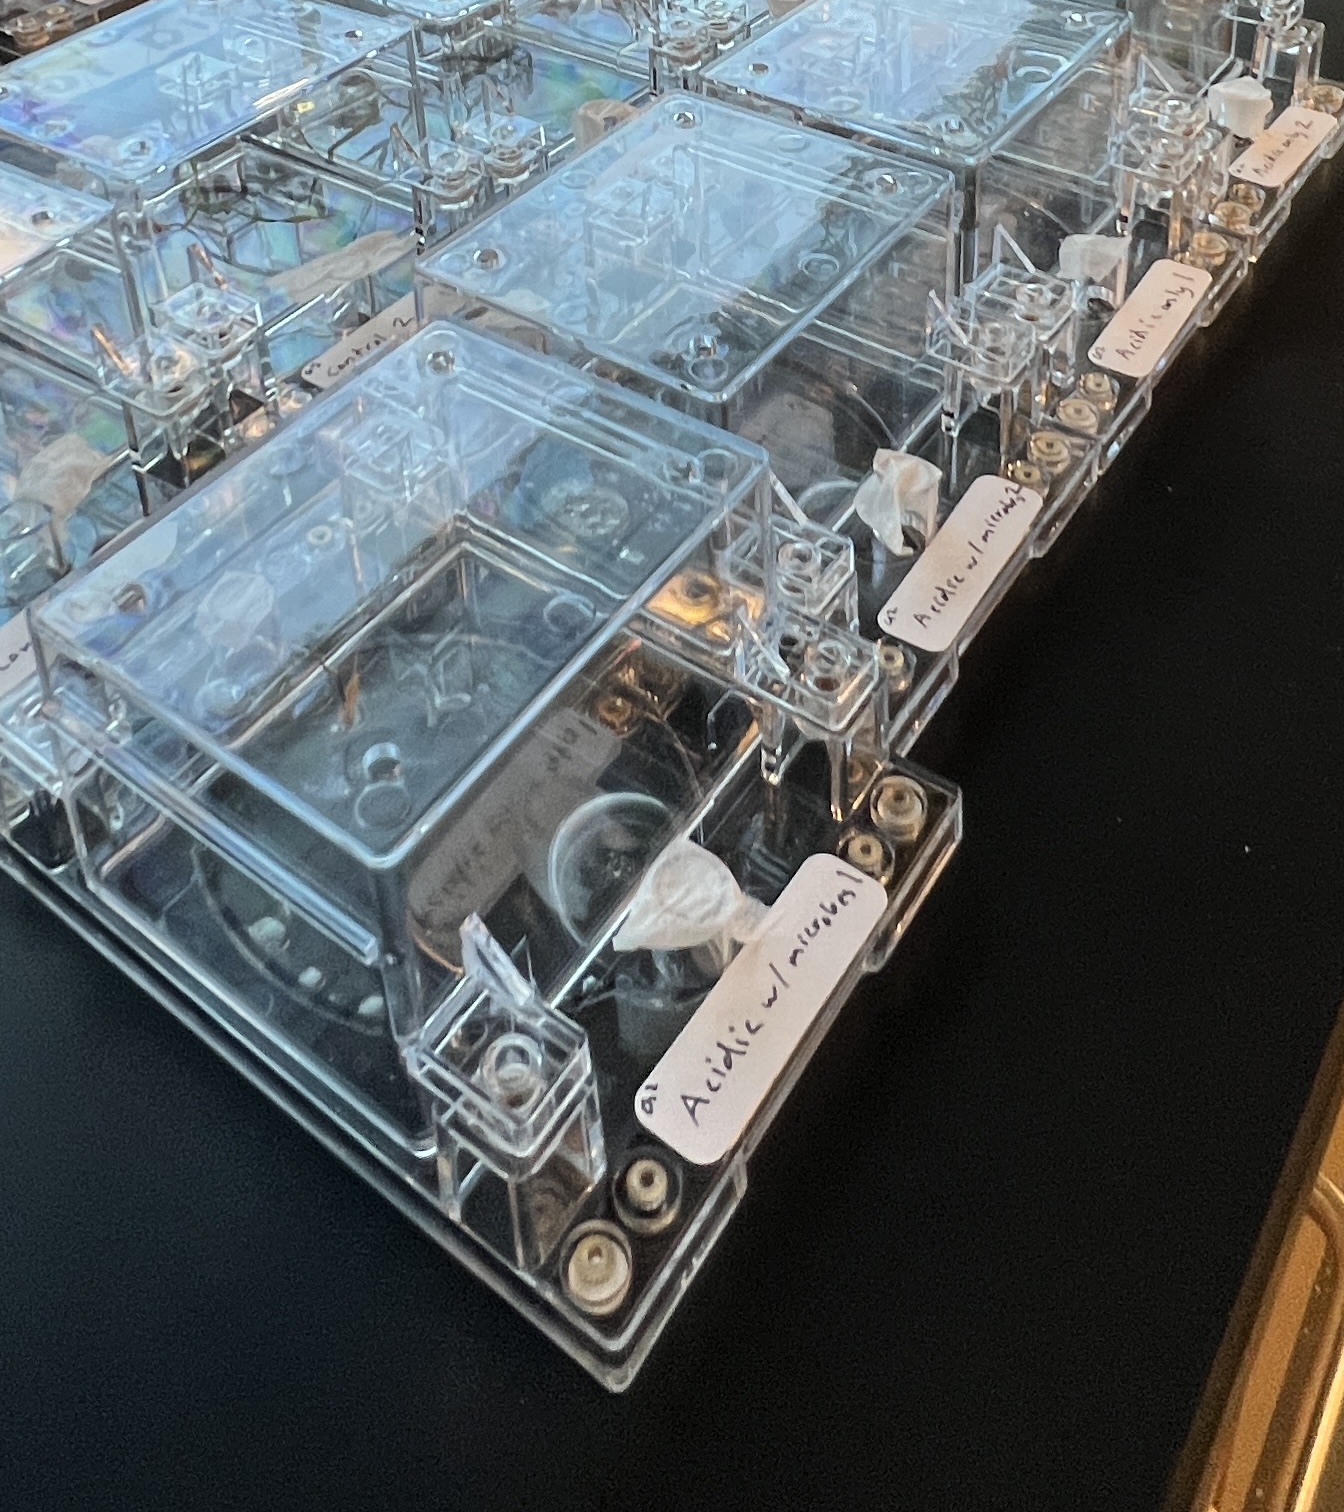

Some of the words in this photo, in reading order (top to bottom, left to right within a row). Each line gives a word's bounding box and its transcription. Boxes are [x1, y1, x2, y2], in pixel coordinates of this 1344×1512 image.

[1115, 313, 1162, 361] Acidic
[1162, 285, 1195, 311] only
[680, 1020, 764, 1128] Acidic
[761, 961, 791, 1011] w/
